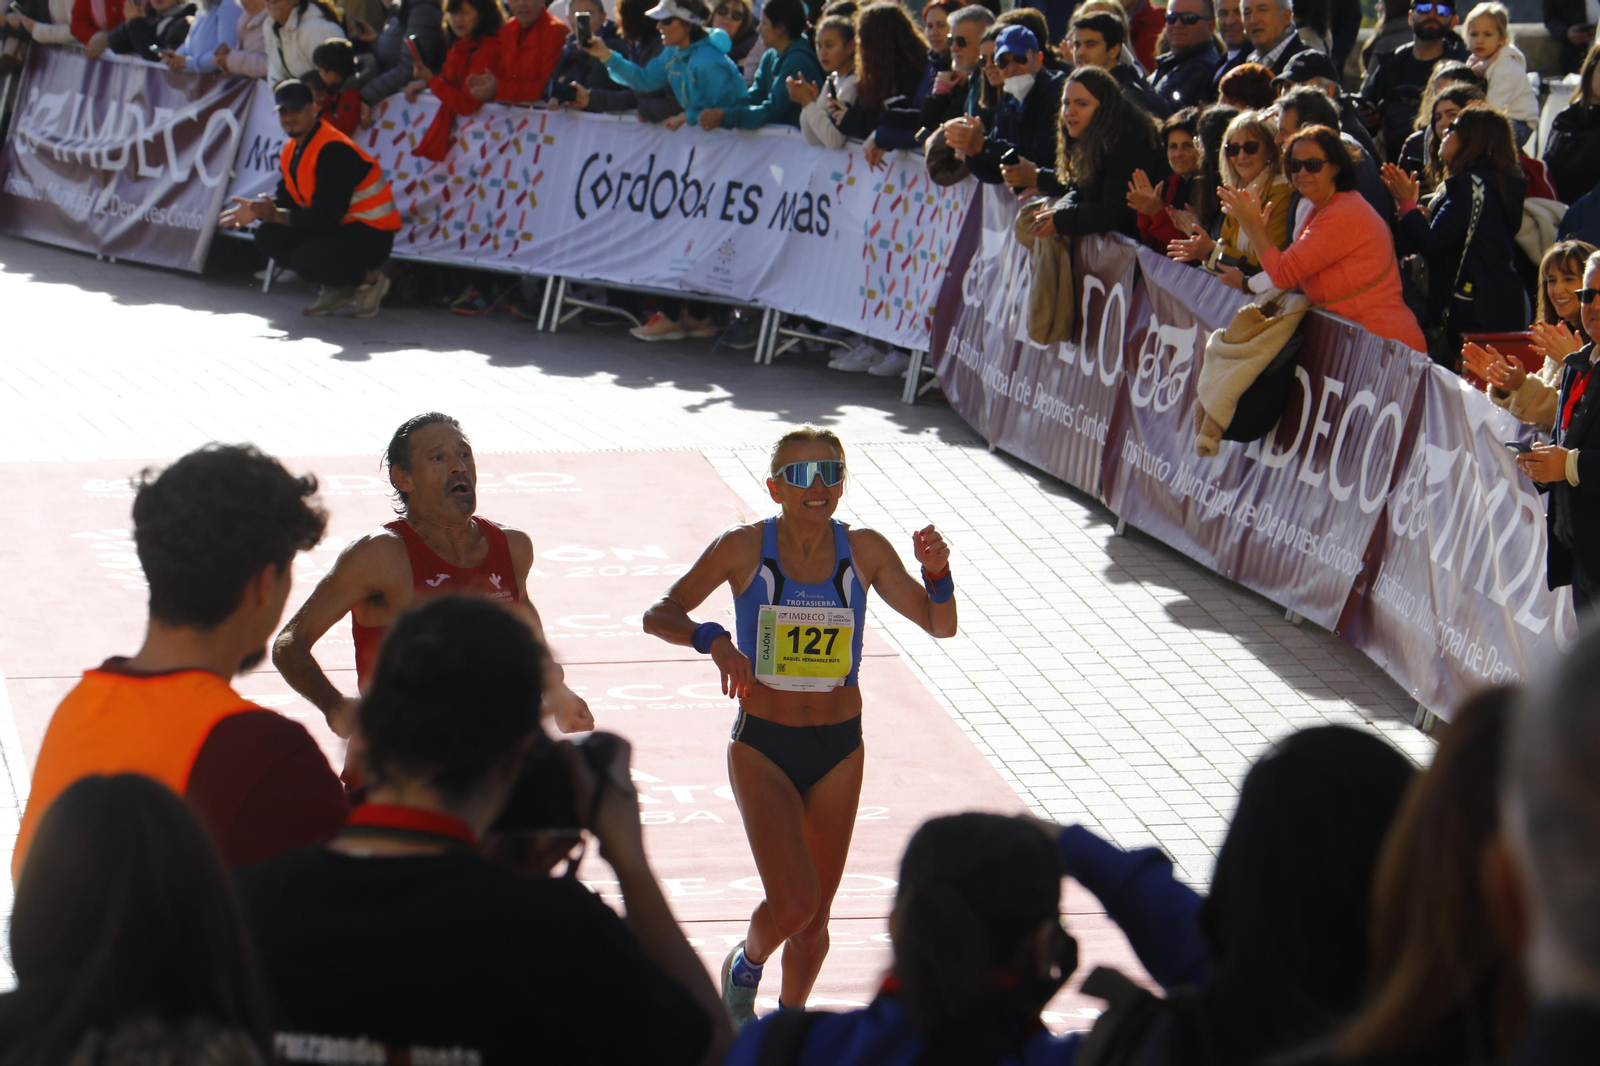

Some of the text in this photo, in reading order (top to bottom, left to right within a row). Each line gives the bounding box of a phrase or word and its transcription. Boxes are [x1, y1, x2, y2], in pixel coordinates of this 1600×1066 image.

[53, 92, 239, 188] IMDECO
[720, 181, 763, 225] ES
[1015, 376, 1031, 405] de
[1122, 430, 1171, 482] Instituto
[1236, 502, 1256, 527] de
[1256, 503, 1320, 556] Deportes
[786, 599, 837, 607] TROTASIERRA
[789, 612, 825, 621] IMDECO
[762, 631, 771, 660] CAJÓN
[787, 627, 840, 656] 127
[1465, 635, 1483, 672] de
